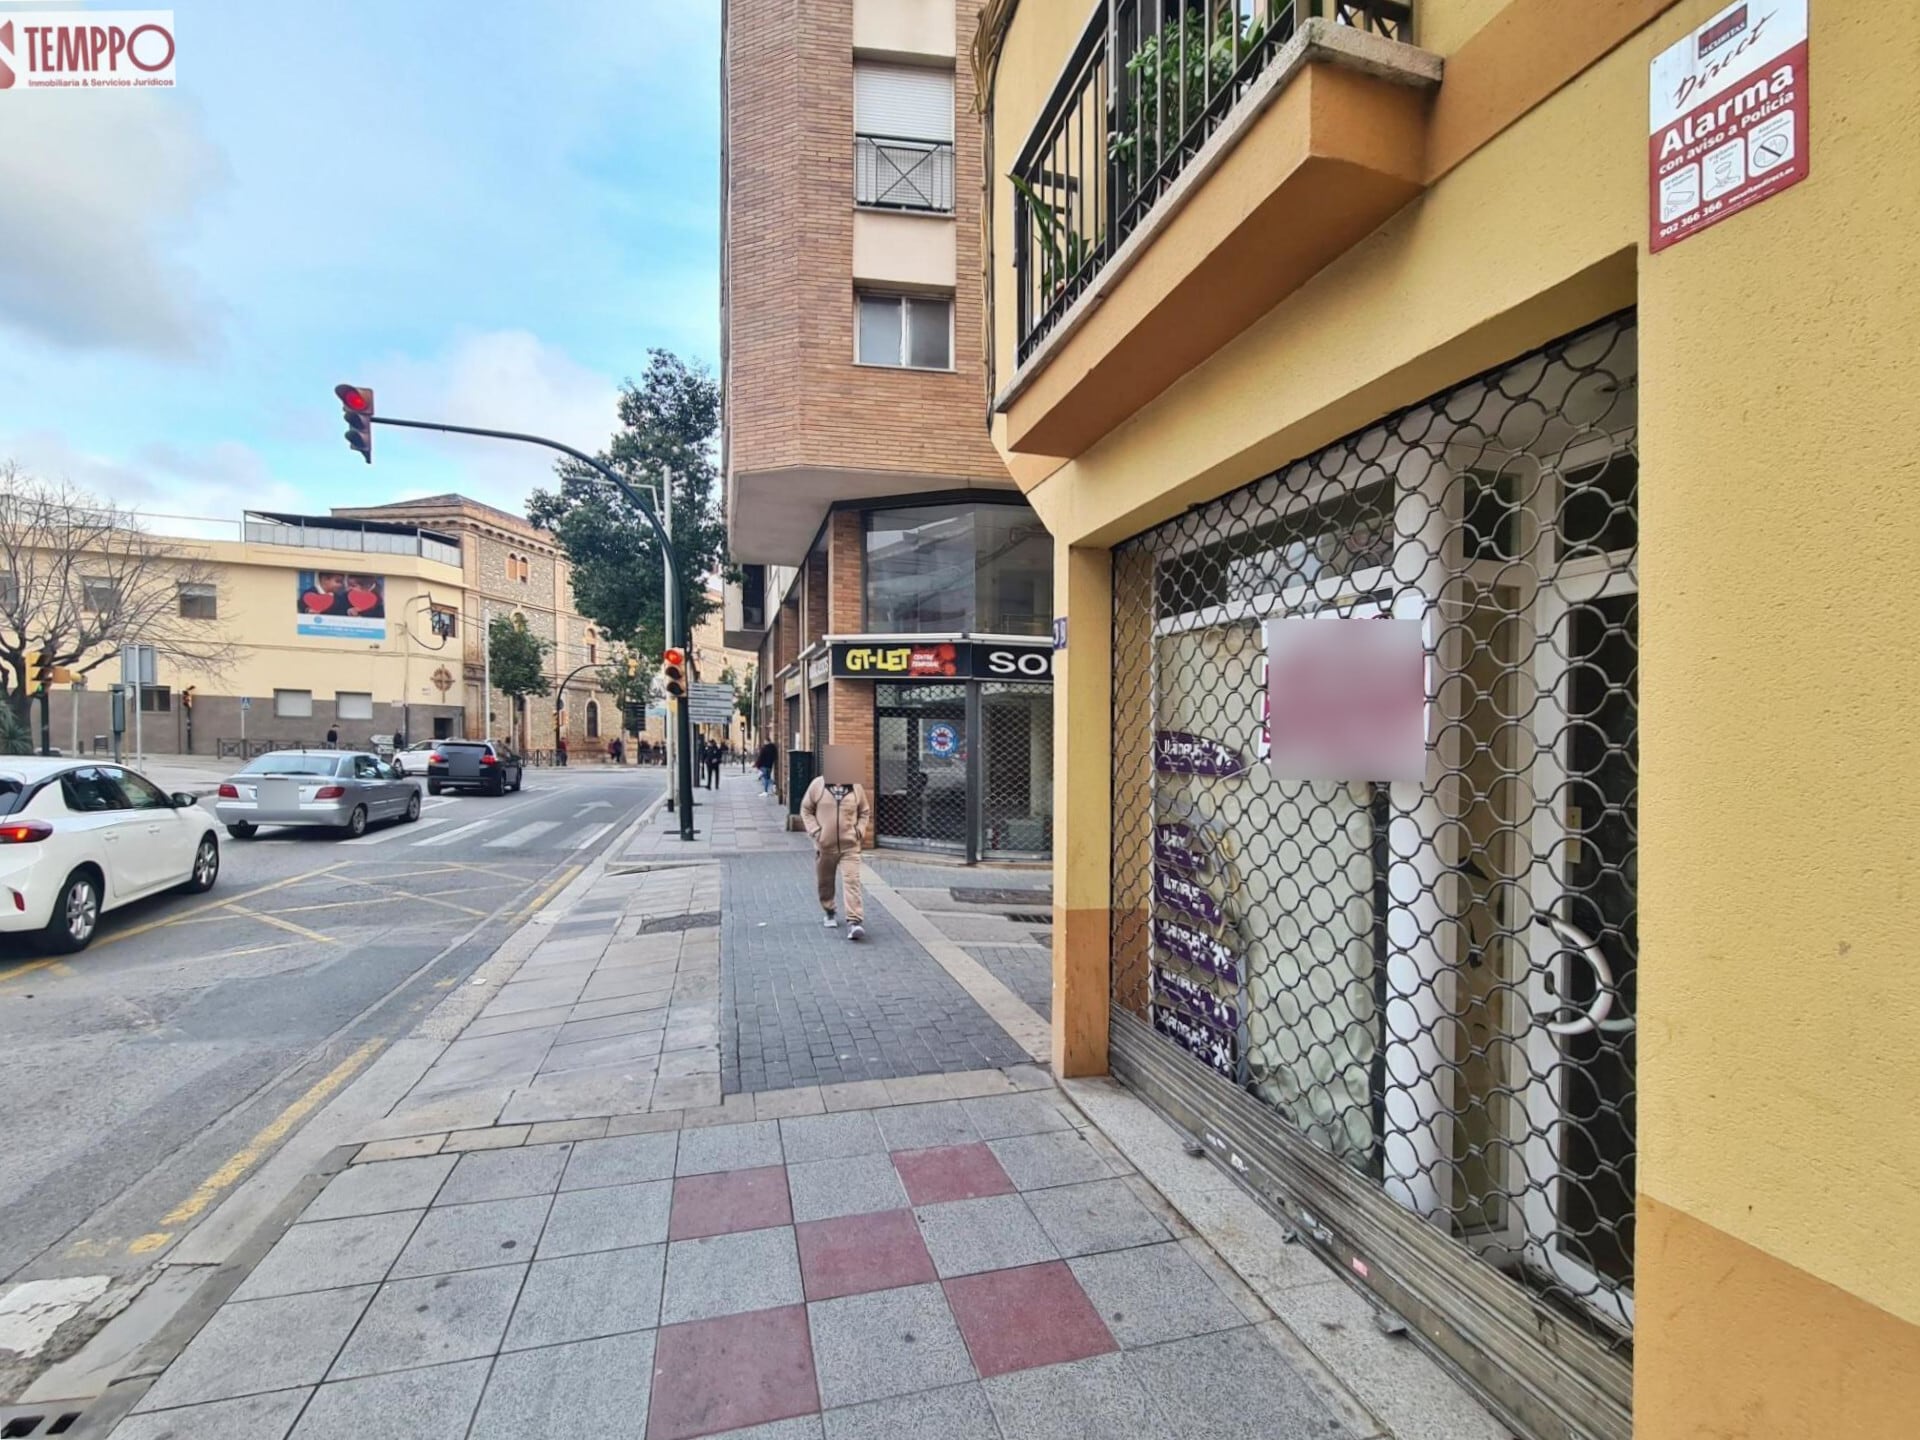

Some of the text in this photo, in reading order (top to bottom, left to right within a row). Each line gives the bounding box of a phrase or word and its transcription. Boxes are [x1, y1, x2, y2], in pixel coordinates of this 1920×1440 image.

[1673, 8, 1778, 109] Direct
[1658, 64, 1794, 161] Alarma
[1659, 155, 1684, 175] con
[1687, 132, 1725, 159] aviso
[1728, 124, 1738, 136] a
[1741, 91, 1794, 129] Policía
[1659, 222, 1679, 238] 902
[1681, 211, 1701, 228] 366
[1703, 200, 1723, 217] 366
[846, 648, 911, 671] GT-LET
[989, 651, 1053, 675] SO
